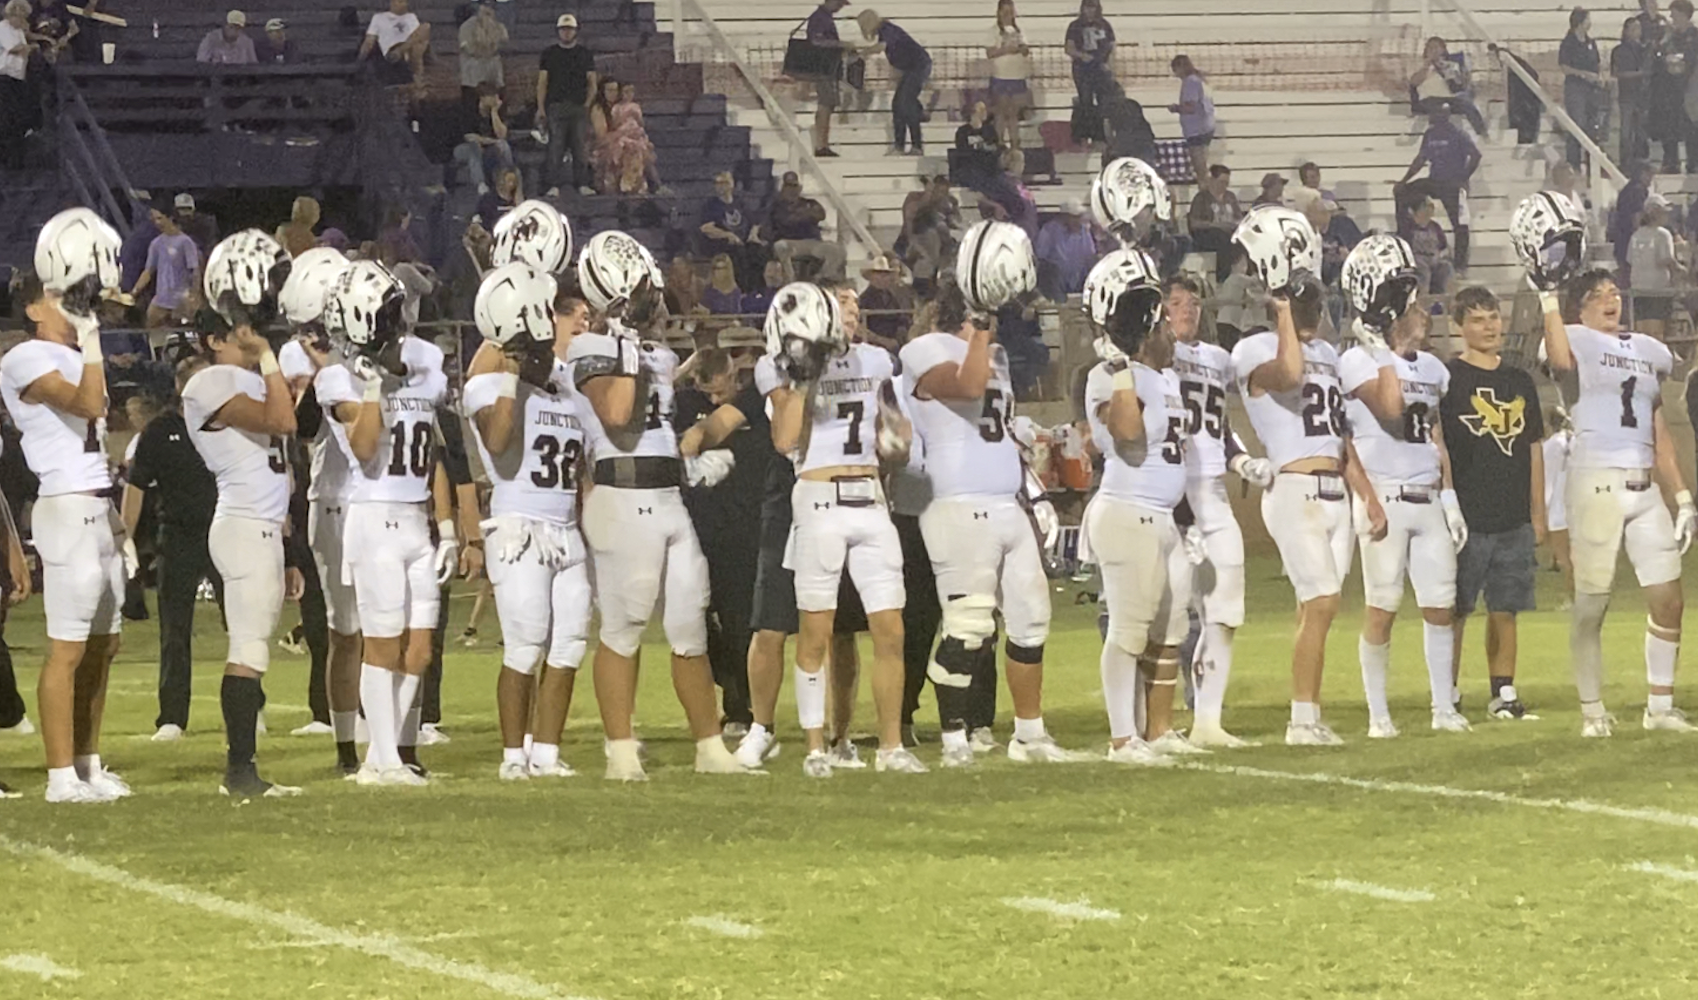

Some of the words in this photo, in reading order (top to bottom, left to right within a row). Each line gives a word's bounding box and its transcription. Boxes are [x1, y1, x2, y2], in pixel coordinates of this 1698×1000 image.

[837, 401, 863, 454] 7
[1180, 381, 1225, 439] 55
[1302, 383, 1342, 437] 28
[1621, 375, 1638, 428] 1
[388, 420, 431, 478] 10
[531, 434, 581, 490] 32
